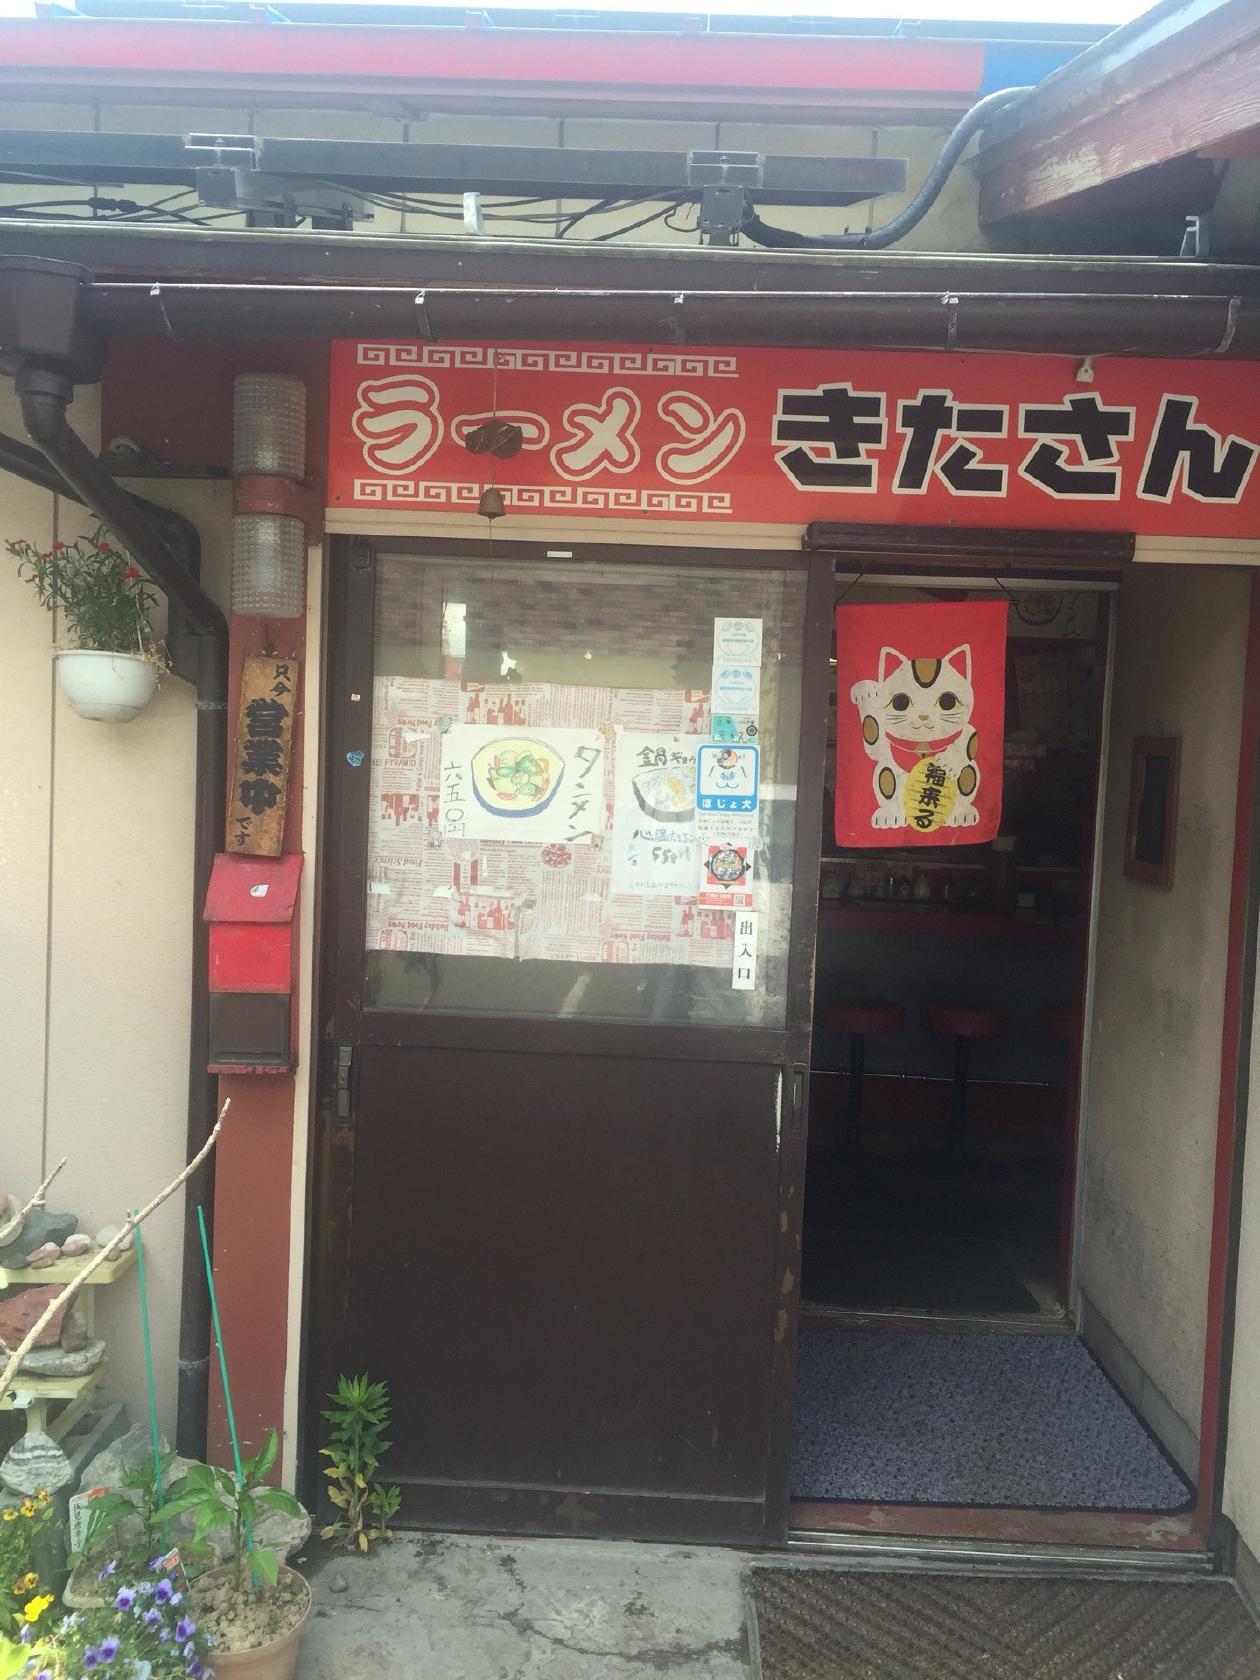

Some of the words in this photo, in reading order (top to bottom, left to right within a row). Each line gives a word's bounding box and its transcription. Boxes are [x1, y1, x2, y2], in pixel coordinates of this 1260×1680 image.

[352, 374, 746, 485] ラーメン
[772, 382, 1260, 505] きたさん
[564, 746, 601, 842] タンメン
[914, 763, 947, 829] 福来る
[738, 921, 753, 980] 出入口
